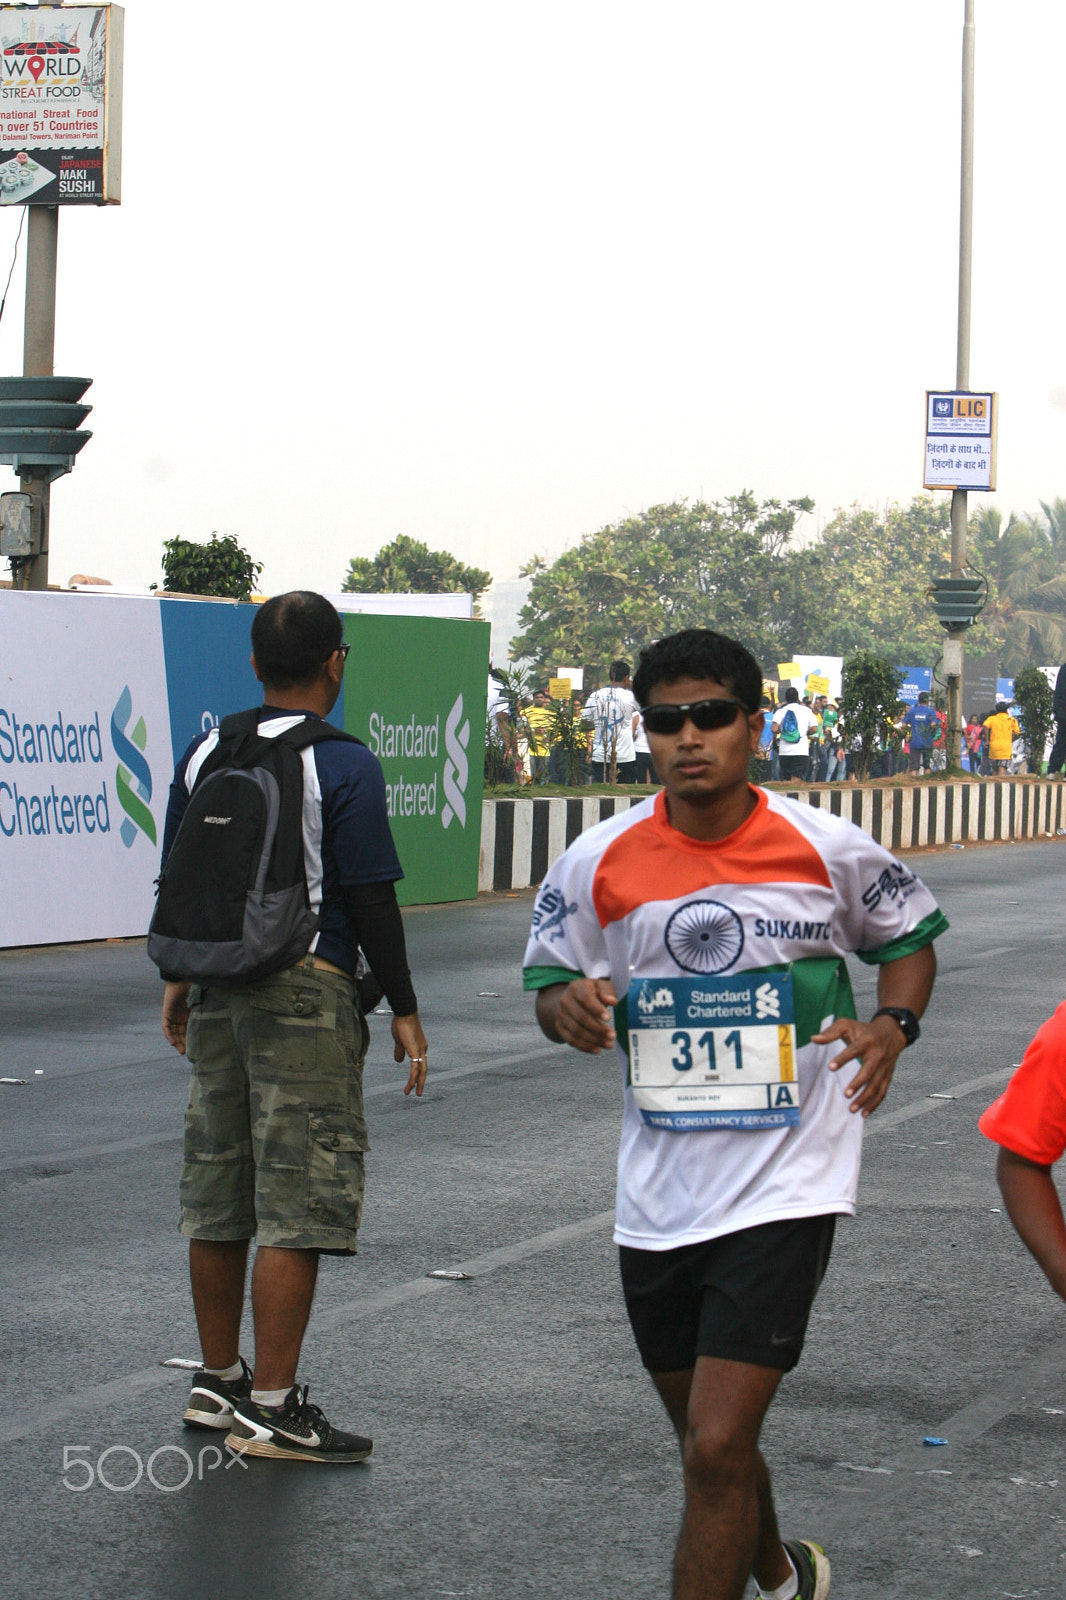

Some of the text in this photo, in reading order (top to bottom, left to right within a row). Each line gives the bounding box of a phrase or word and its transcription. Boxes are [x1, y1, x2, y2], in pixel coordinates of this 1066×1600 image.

[4, 56, 81, 84] WORLD
[2, 86, 81, 99] STREAT FOOD
[43, 109, 71, 119] Streat
[76, 108, 99, 118] Food
[7, 123, 30, 132] over
[33, 121, 45, 131] 51
[49, 120, 99, 131] Countries
[29, 133, 54, 141] Towers,
[54, 132, 81, 140] Nariman
[82, 131, 99, 139] Point
[59, 160, 102, 169] JAPANESE
[59, 169, 87, 180] MAKI
[58, 180, 96, 193] SUSHI
[957, 400, 984, 417] LIC
[977, 459, 987, 470] भी
[0, 708, 103, 764] Standard
[368, 712, 439, 758] Standard
[385, 772, 438, 817] artered
[0, 781, 111, 837] Chartered
[691, 989, 750, 1004] Standard
[686, 1004, 752, 1019] Chartered
[671, 1030, 743, 1072] 311
[775, 1086, 794, 1106] A
[650, 1113, 786, 1127] TATA CONSULTANCY SERVICES
